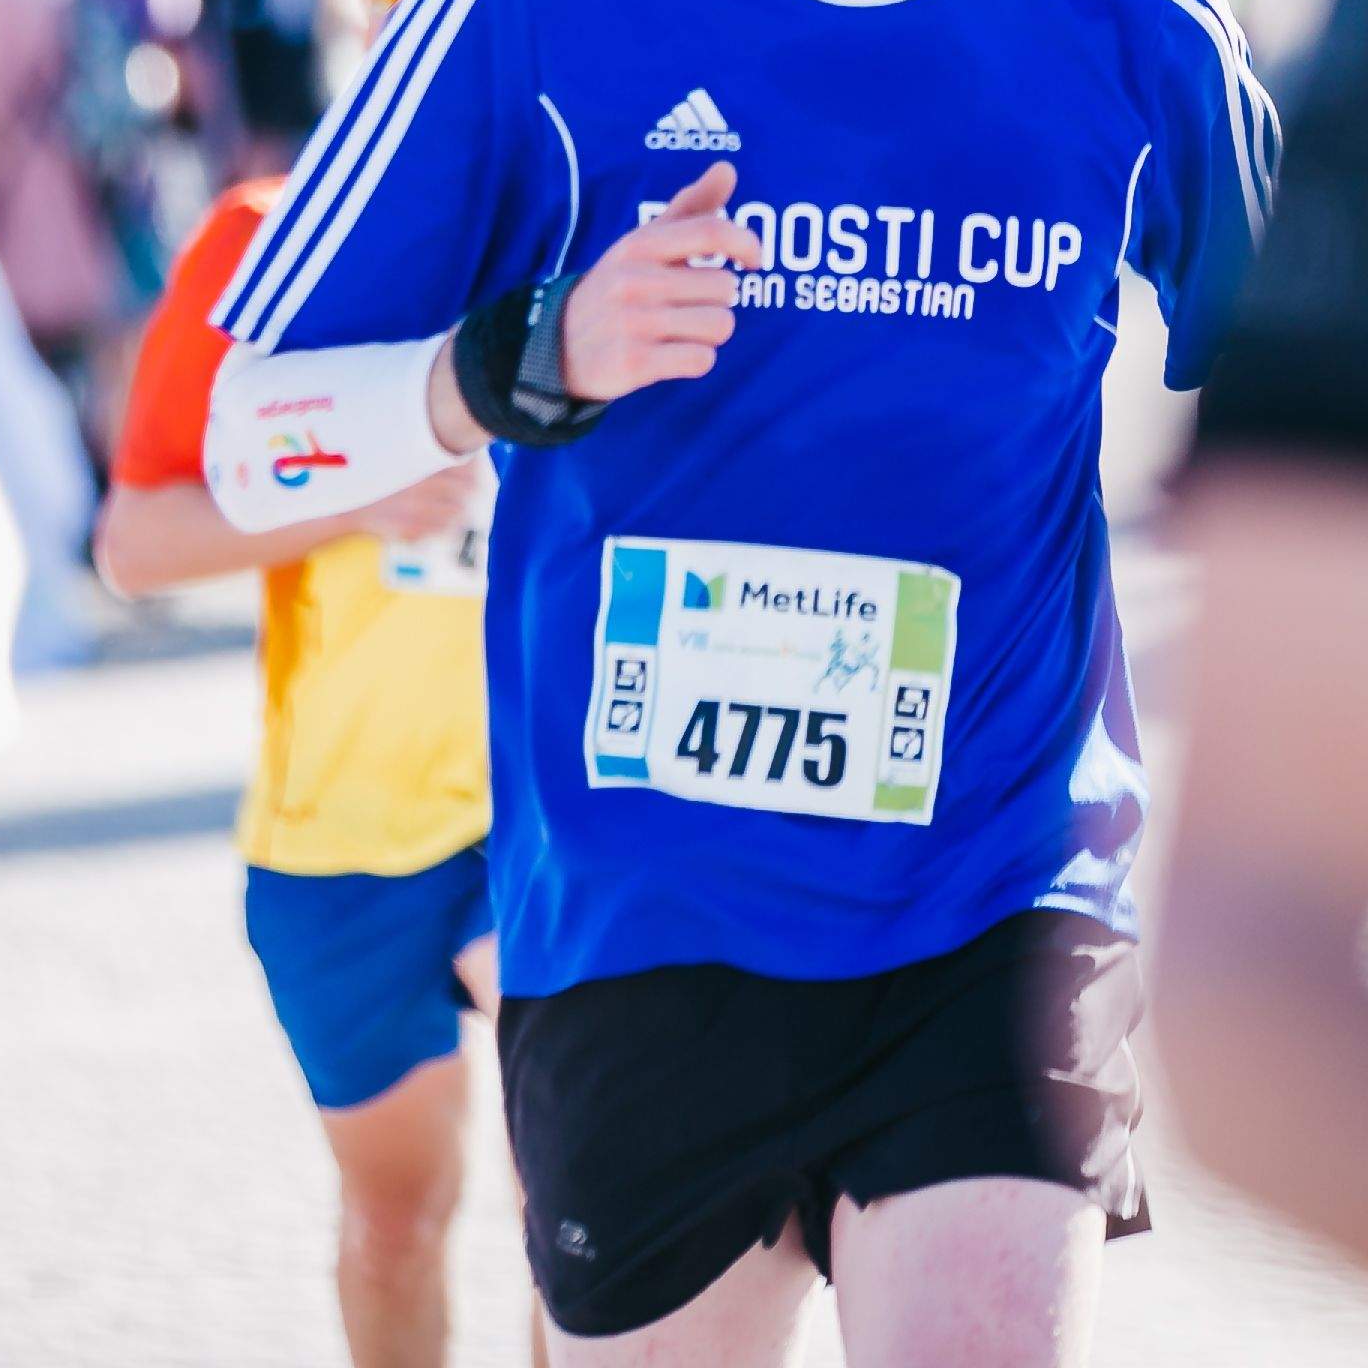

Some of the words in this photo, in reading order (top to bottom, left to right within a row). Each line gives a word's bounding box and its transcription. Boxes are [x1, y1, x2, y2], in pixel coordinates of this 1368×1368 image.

[645, 130, 741, 152] adidas
[959, 213, 1082, 292] CUP
[795, 274, 975, 320] SEBASTIAN
[740, 582, 878, 621] MetLife
[676, 698, 848, 788] 4775
